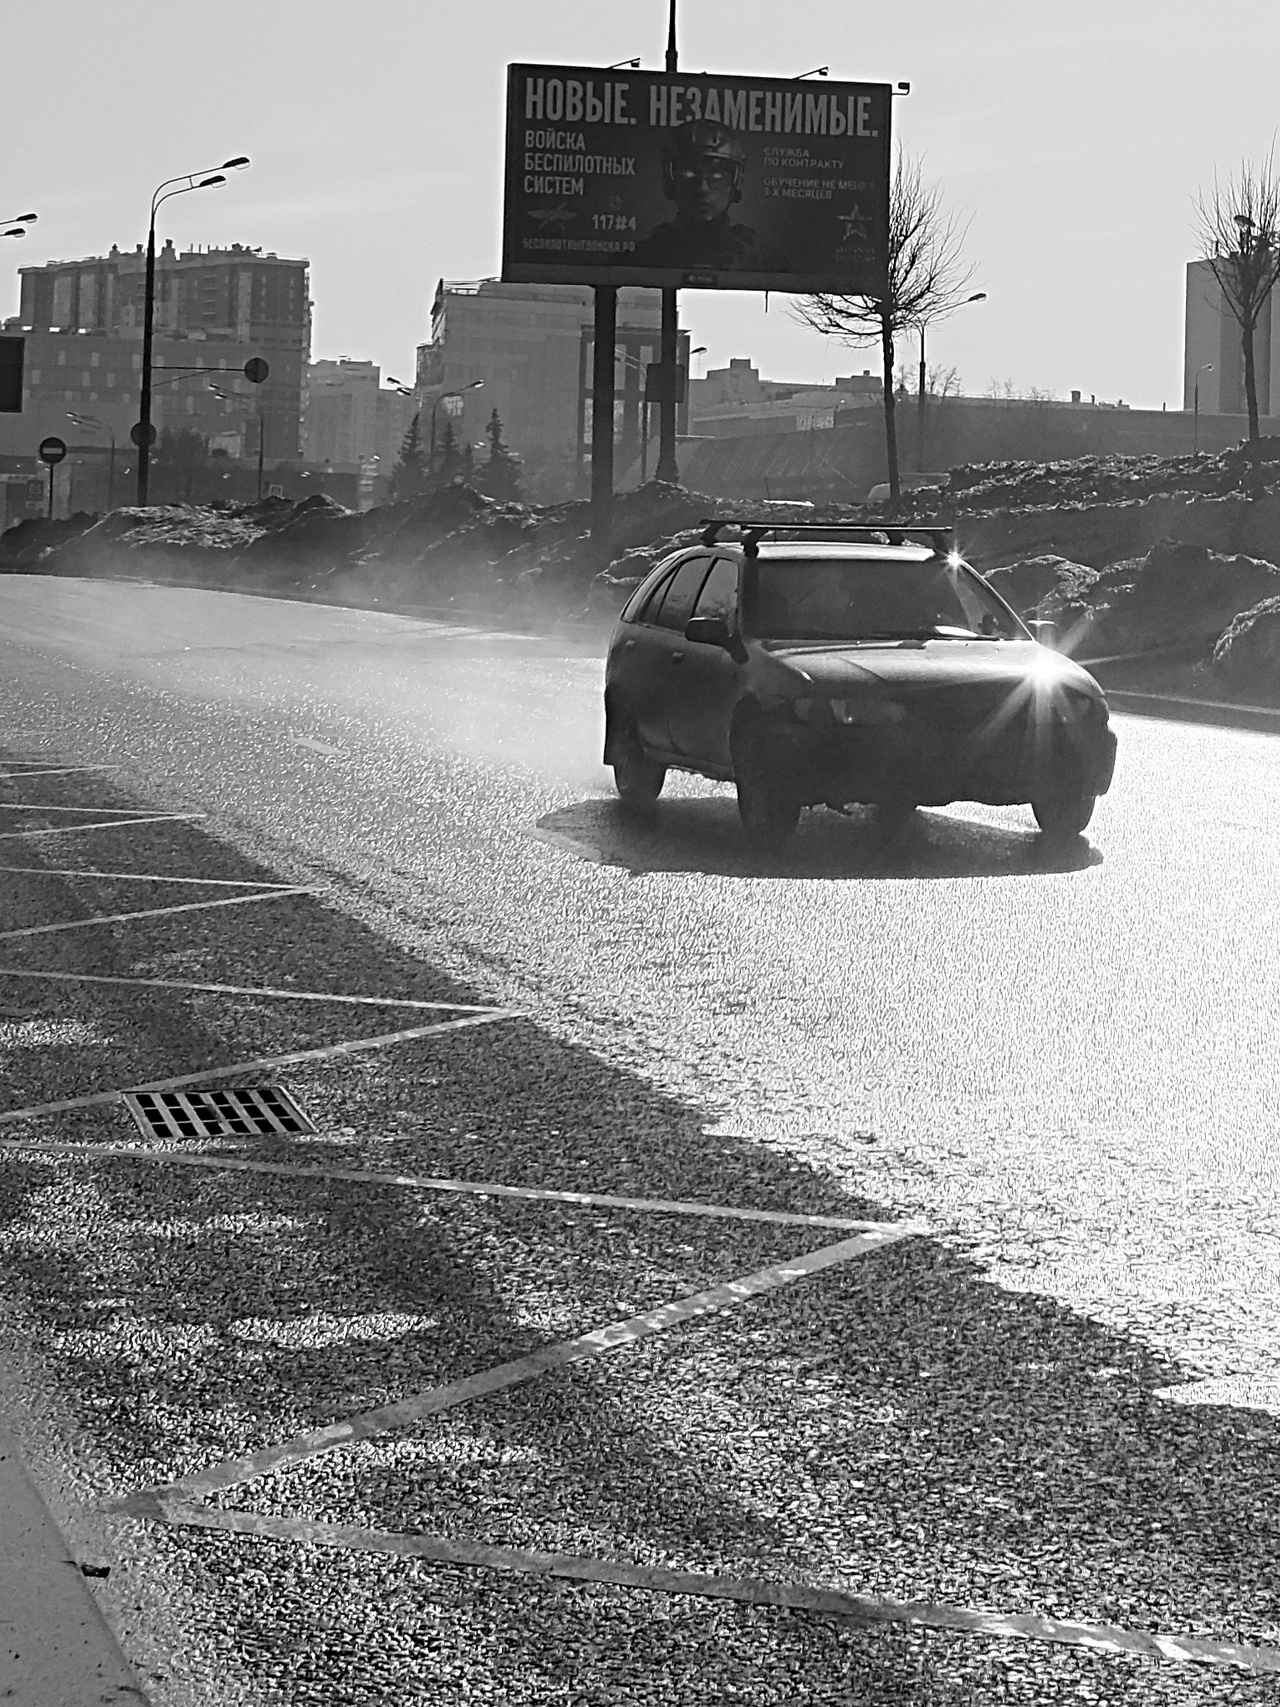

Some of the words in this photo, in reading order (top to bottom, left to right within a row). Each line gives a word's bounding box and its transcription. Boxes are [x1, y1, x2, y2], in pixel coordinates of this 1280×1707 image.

[525, 77, 637, 125] НОВЫЕ.
[649, 84, 879, 137] НЕЗАМЕНИМЫЕ.
[525, 128, 586, 151] ВОЙСКА
[764, 146, 810, 158] СЛУЖБА
[524, 152, 636, 176] БЕСПИЛОТНЫХ
[764, 157, 779, 167] ПО
[781, 158, 845, 170] КОНТРАКТУ
[524, 175, 584, 196] СИСТЕМ
[764, 177, 820, 189] ОБУЧЕНИЕ
[782, 188, 833, 200] МЕСЯЦЕВ
[592, 213, 637, 231] 117#4
